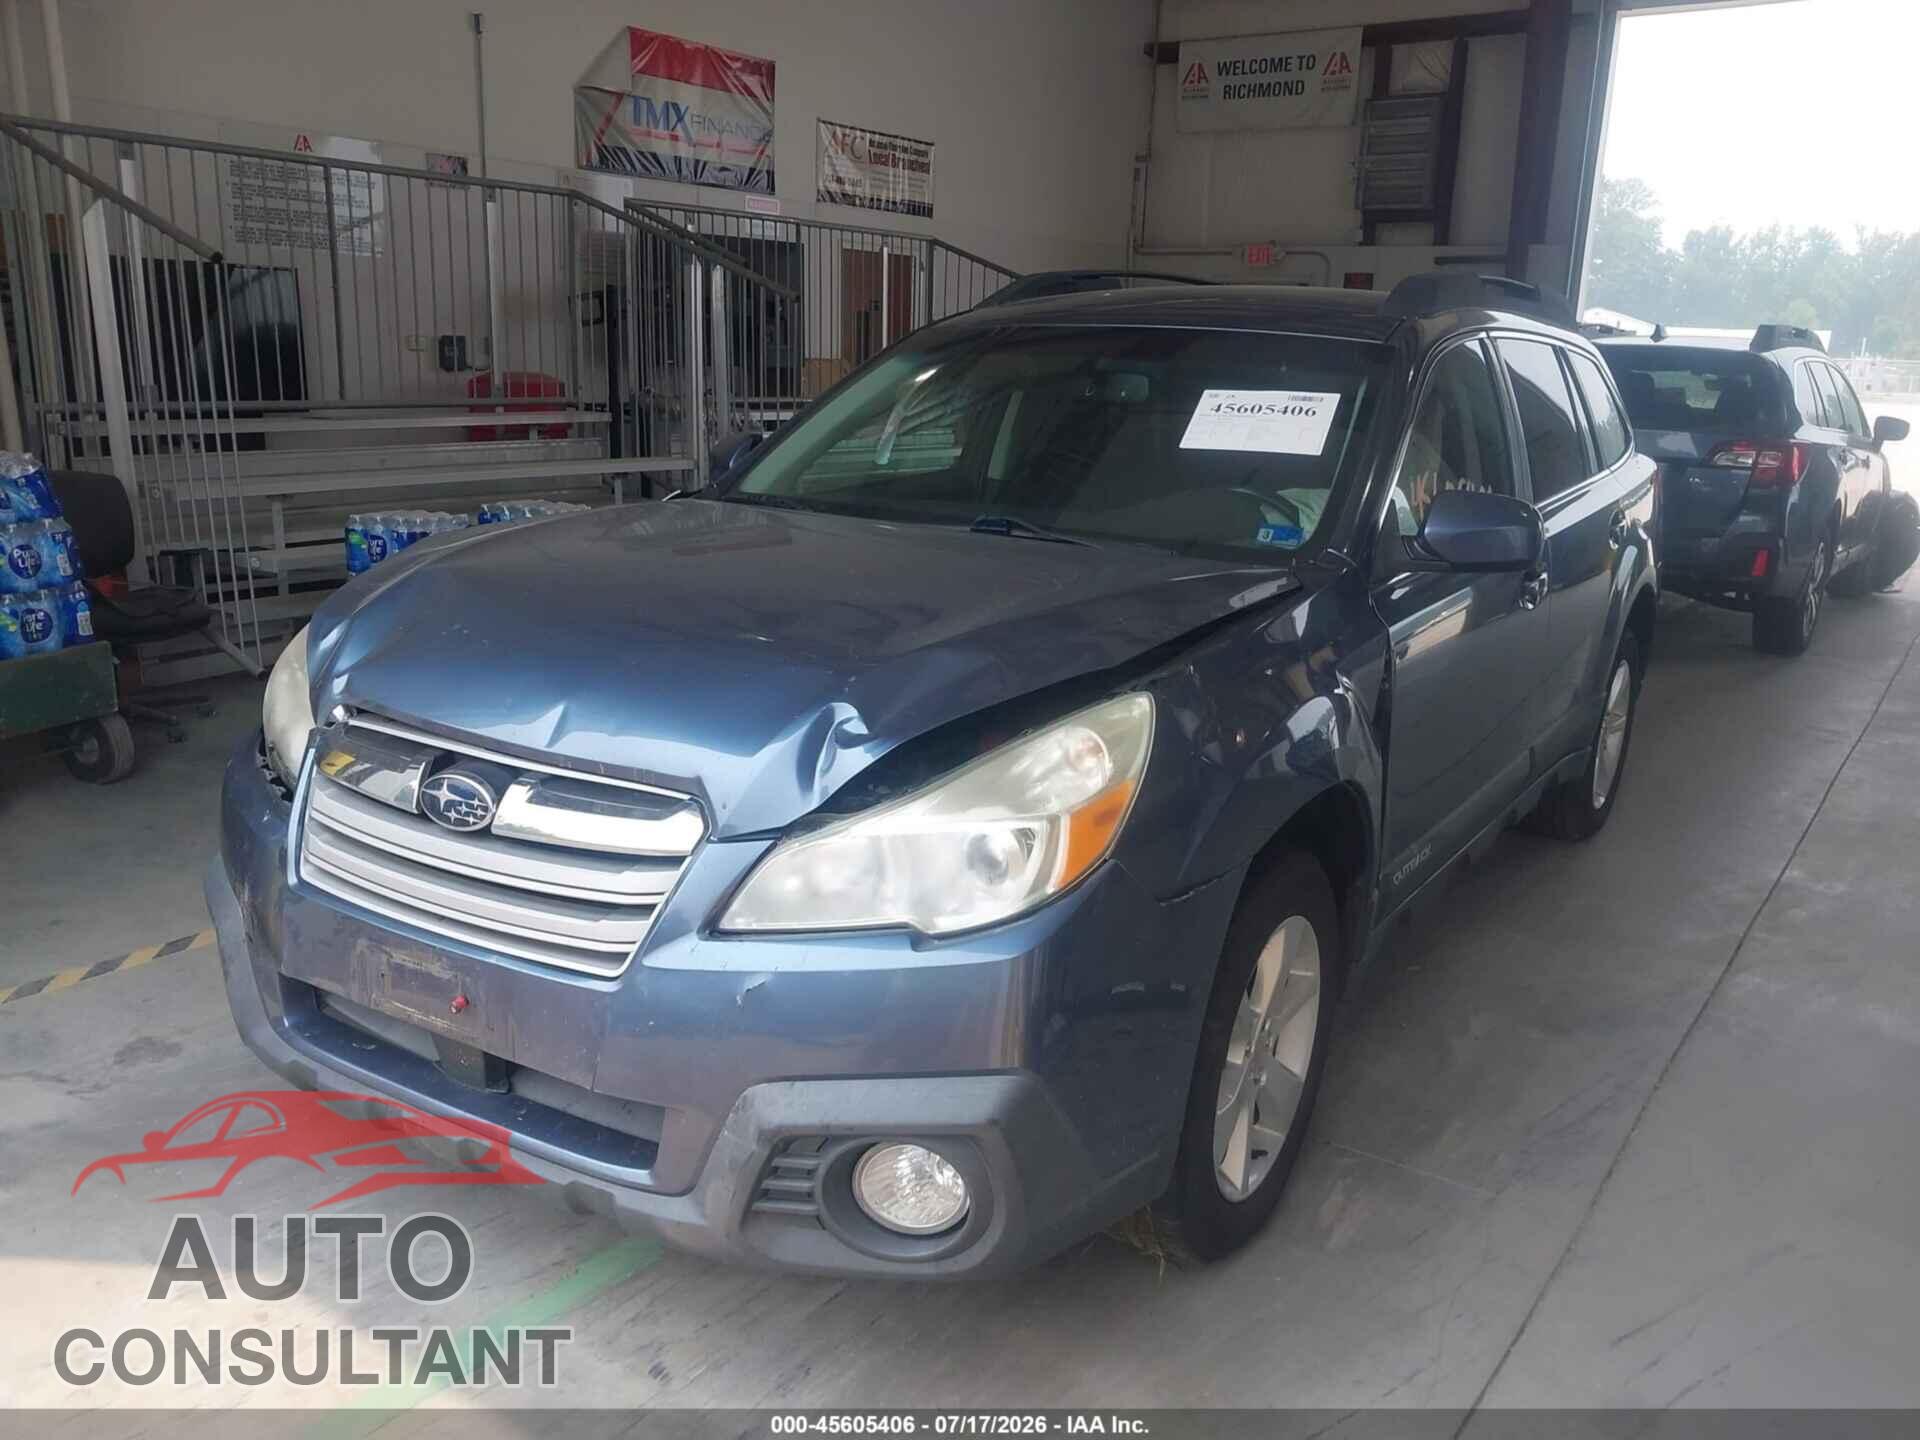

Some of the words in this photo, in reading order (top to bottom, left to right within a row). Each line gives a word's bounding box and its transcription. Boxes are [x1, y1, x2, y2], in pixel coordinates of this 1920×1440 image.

[1217, 56, 1293, 76] WELCOME
[1296, 54, 1316, 71] TO
[1223, 80, 1304, 100] RICHMOND
[630, 95, 697, 146] TMX
[1210, 402, 1317, 417] 45605406
